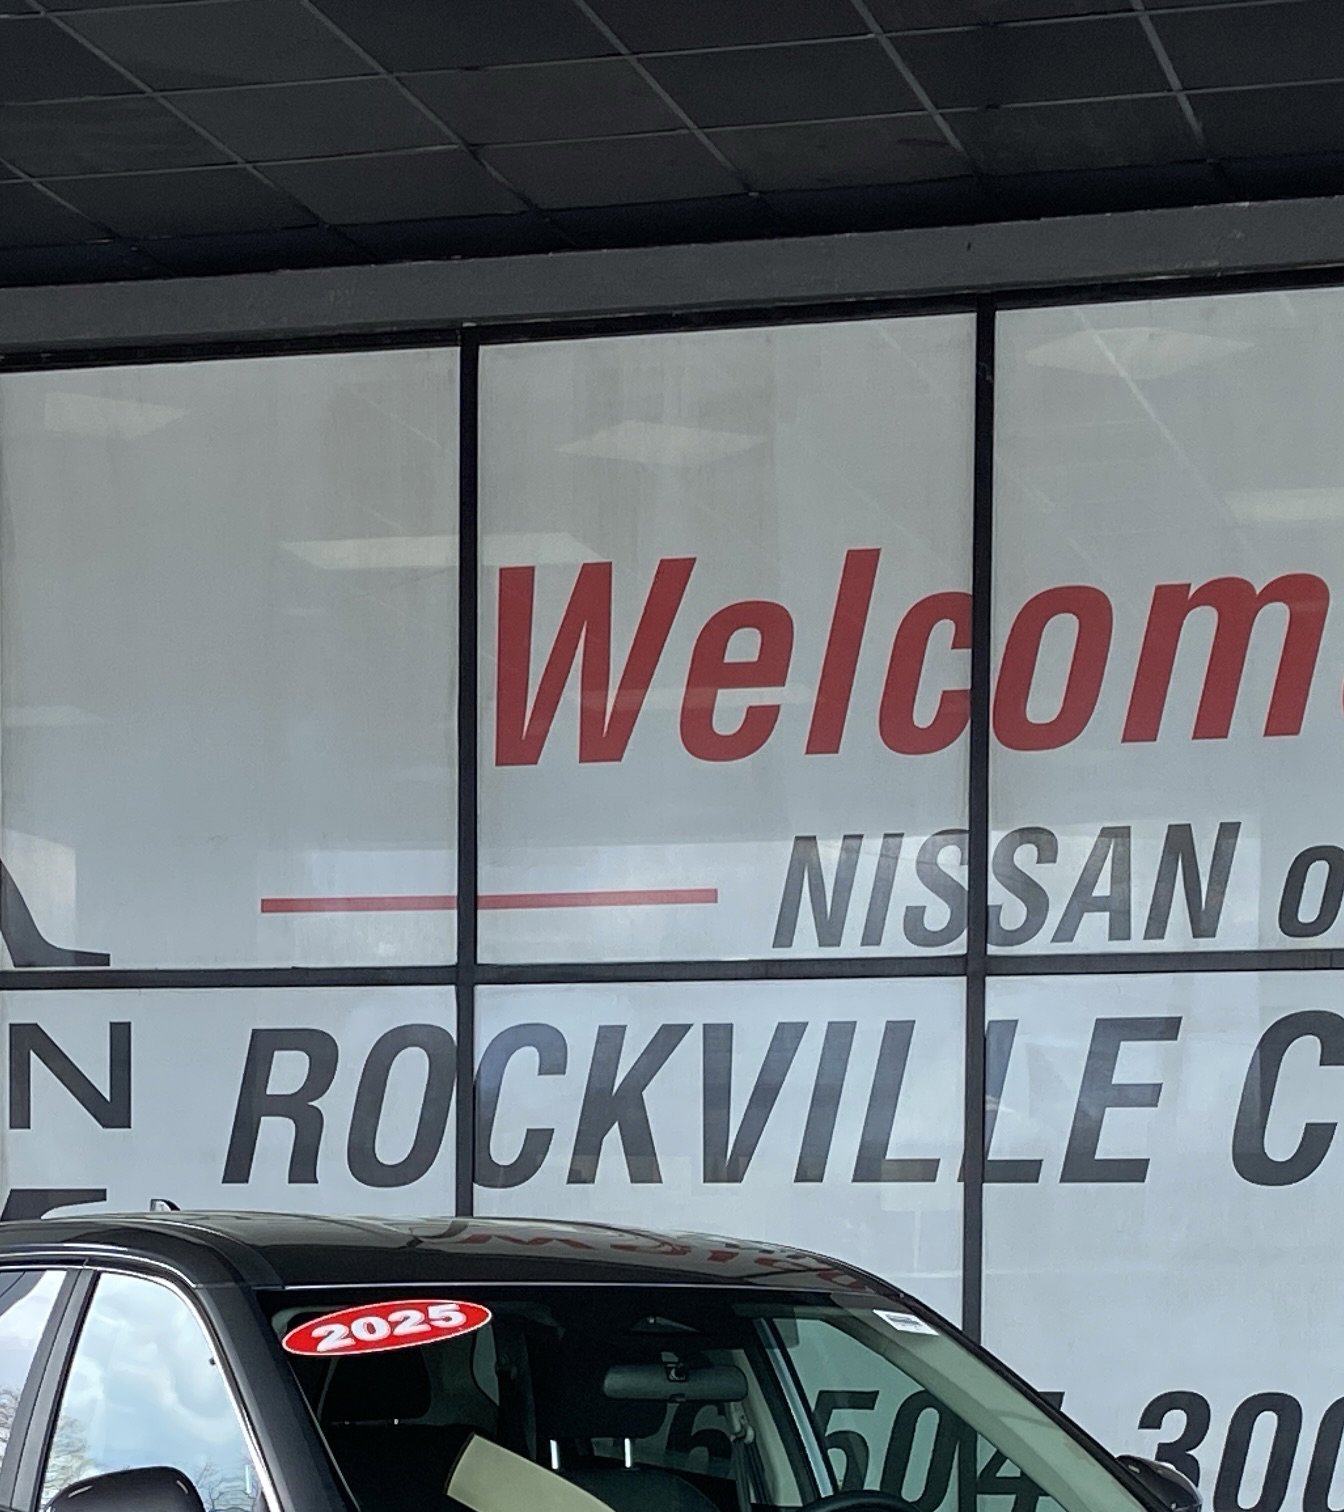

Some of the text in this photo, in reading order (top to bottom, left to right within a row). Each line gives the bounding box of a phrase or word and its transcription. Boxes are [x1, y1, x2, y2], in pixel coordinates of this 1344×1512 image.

[771, 820, 1242, 949] NISSAN
[221, 1015, 1183, 1190] ROCKVILLE
[310, 1303, 468, 1353] 2025
